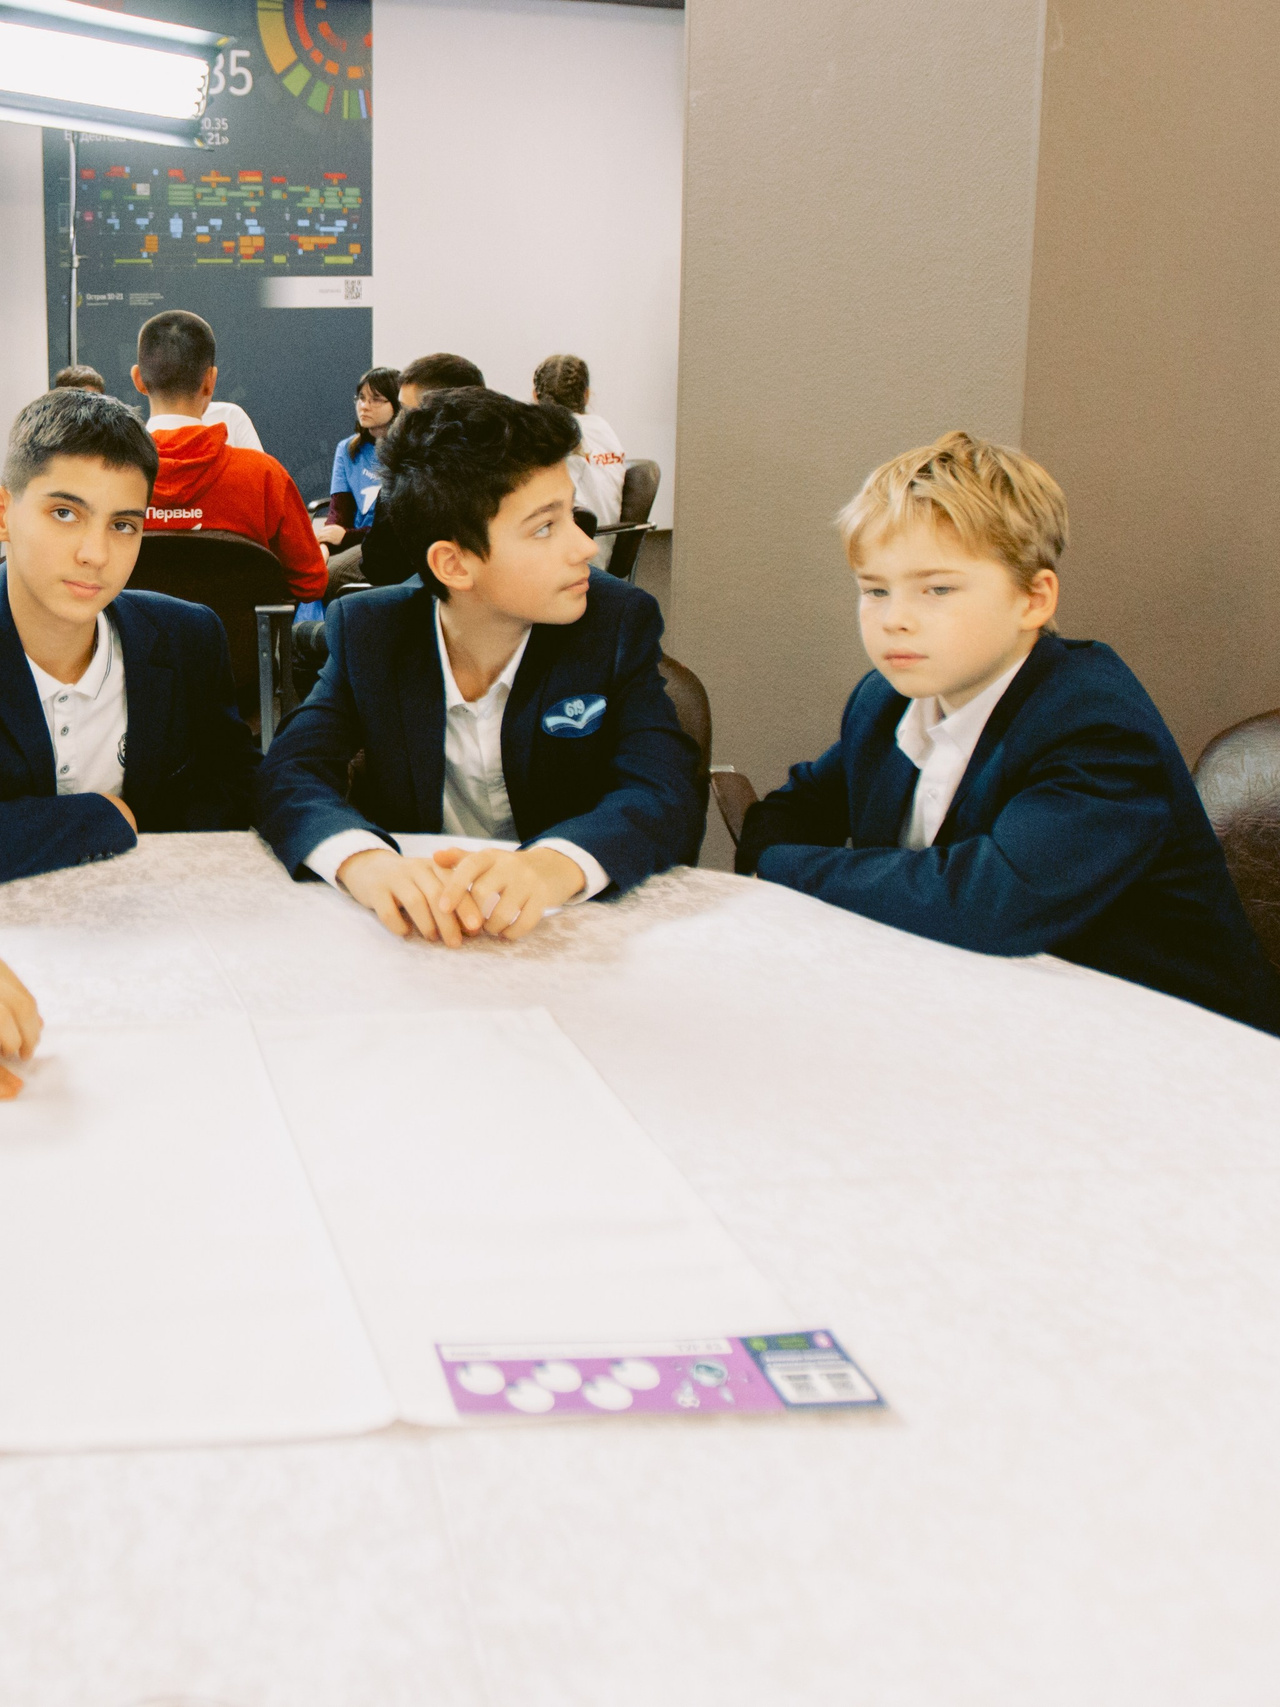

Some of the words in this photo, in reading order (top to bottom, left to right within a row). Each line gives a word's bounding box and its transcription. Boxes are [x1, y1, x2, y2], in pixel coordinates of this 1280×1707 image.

[202, 117, 228, 130] 0.35
[146, 506, 203, 522] Первые
[566, 700, 585, 717] 619
